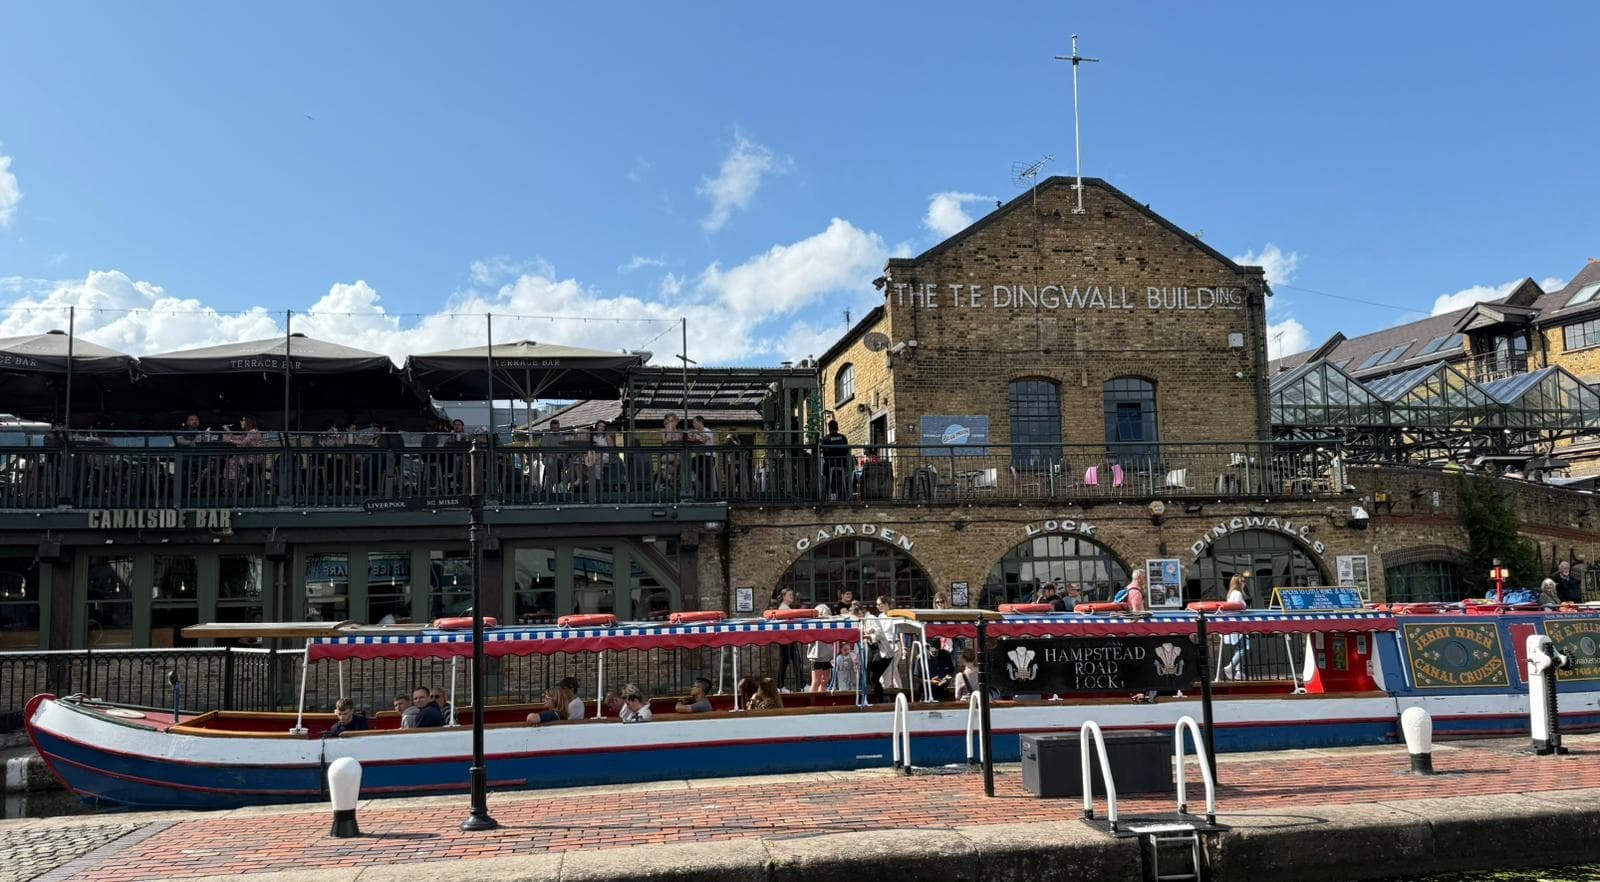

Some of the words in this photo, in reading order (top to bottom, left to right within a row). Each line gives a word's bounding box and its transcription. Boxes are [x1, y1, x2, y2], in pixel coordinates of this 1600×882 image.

[893, 283, 938, 308] THE
[993, 284, 1134, 309] DINGWALL
[1146, 286, 1241, 309] BUILDING
[15, 357, 38, 367] BAR
[231, 359, 277, 368] TERRACE
[88, 508, 186, 528] CANALSIDE
[195, 508, 231, 528] BAR
[796, 523, 914, 551] CAMDEN
[1024, 520, 1097, 536] LOCK
[1415, 626, 1450, 650] JENNY
[1454, 626, 1493, 650] WREN
[1045, 647, 1146, 662] HAMPSTEAD
[1075, 661, 1118, 675] ROAD
[1415, 658, 1457, 683] CANAL
[1459, 655, 1504, 683] CRUISES
